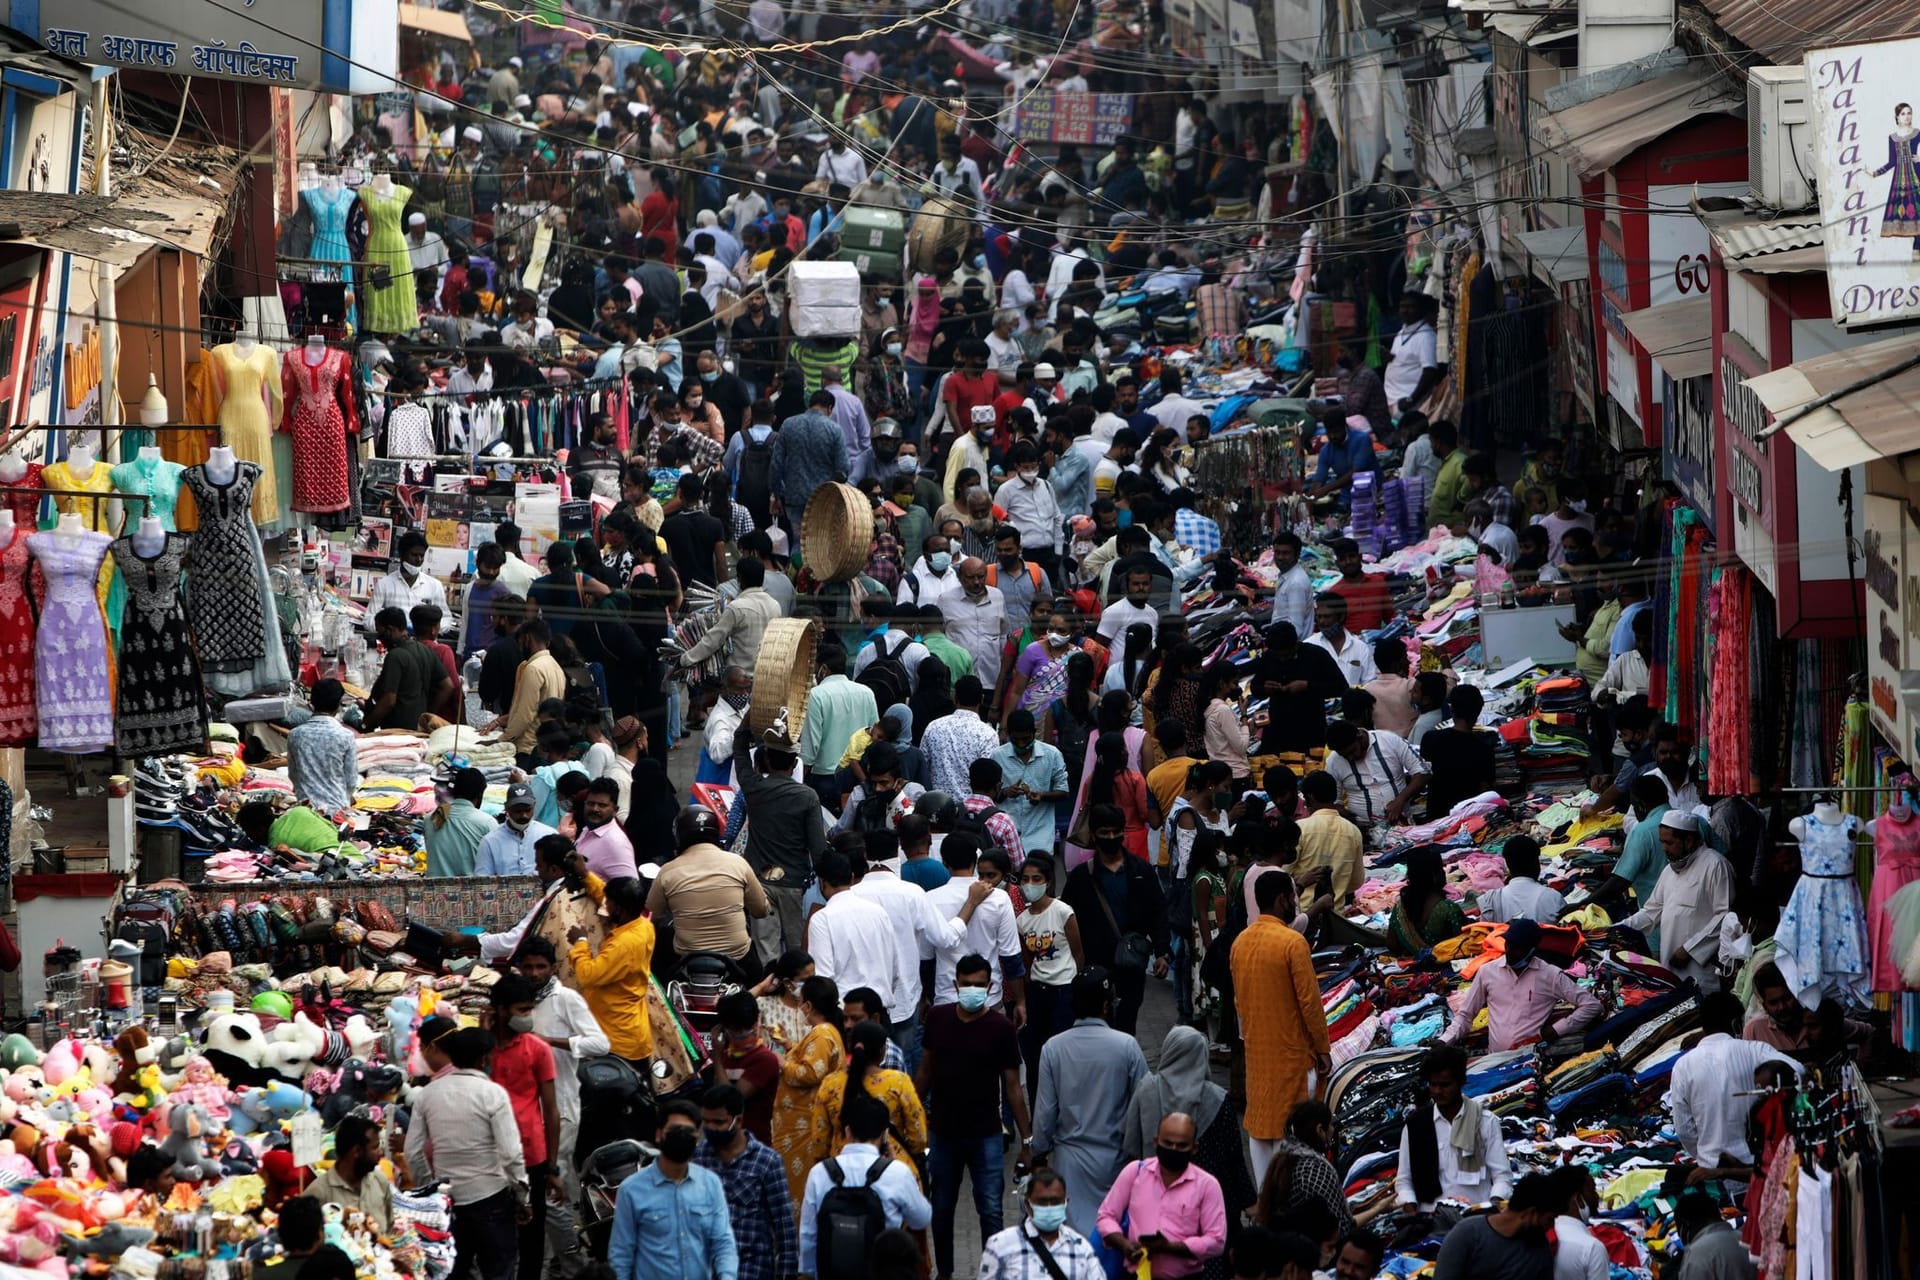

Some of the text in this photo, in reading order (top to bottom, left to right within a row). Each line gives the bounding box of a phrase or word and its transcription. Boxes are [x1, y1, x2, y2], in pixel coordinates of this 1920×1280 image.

[46, 28, 88, 57] अल
[102, 35, 177, 66] अशरफ
[1062, 92, 1089, 102] SALE
[1099, 94, 1128, 104] SALE
[1019, 130, 1048, 140] SALE
[1058, 132, 1086, 142] SALE
[1819, 56, 1871, 265] Maharani
[1733, 446, 1761, 515] TRADERS
